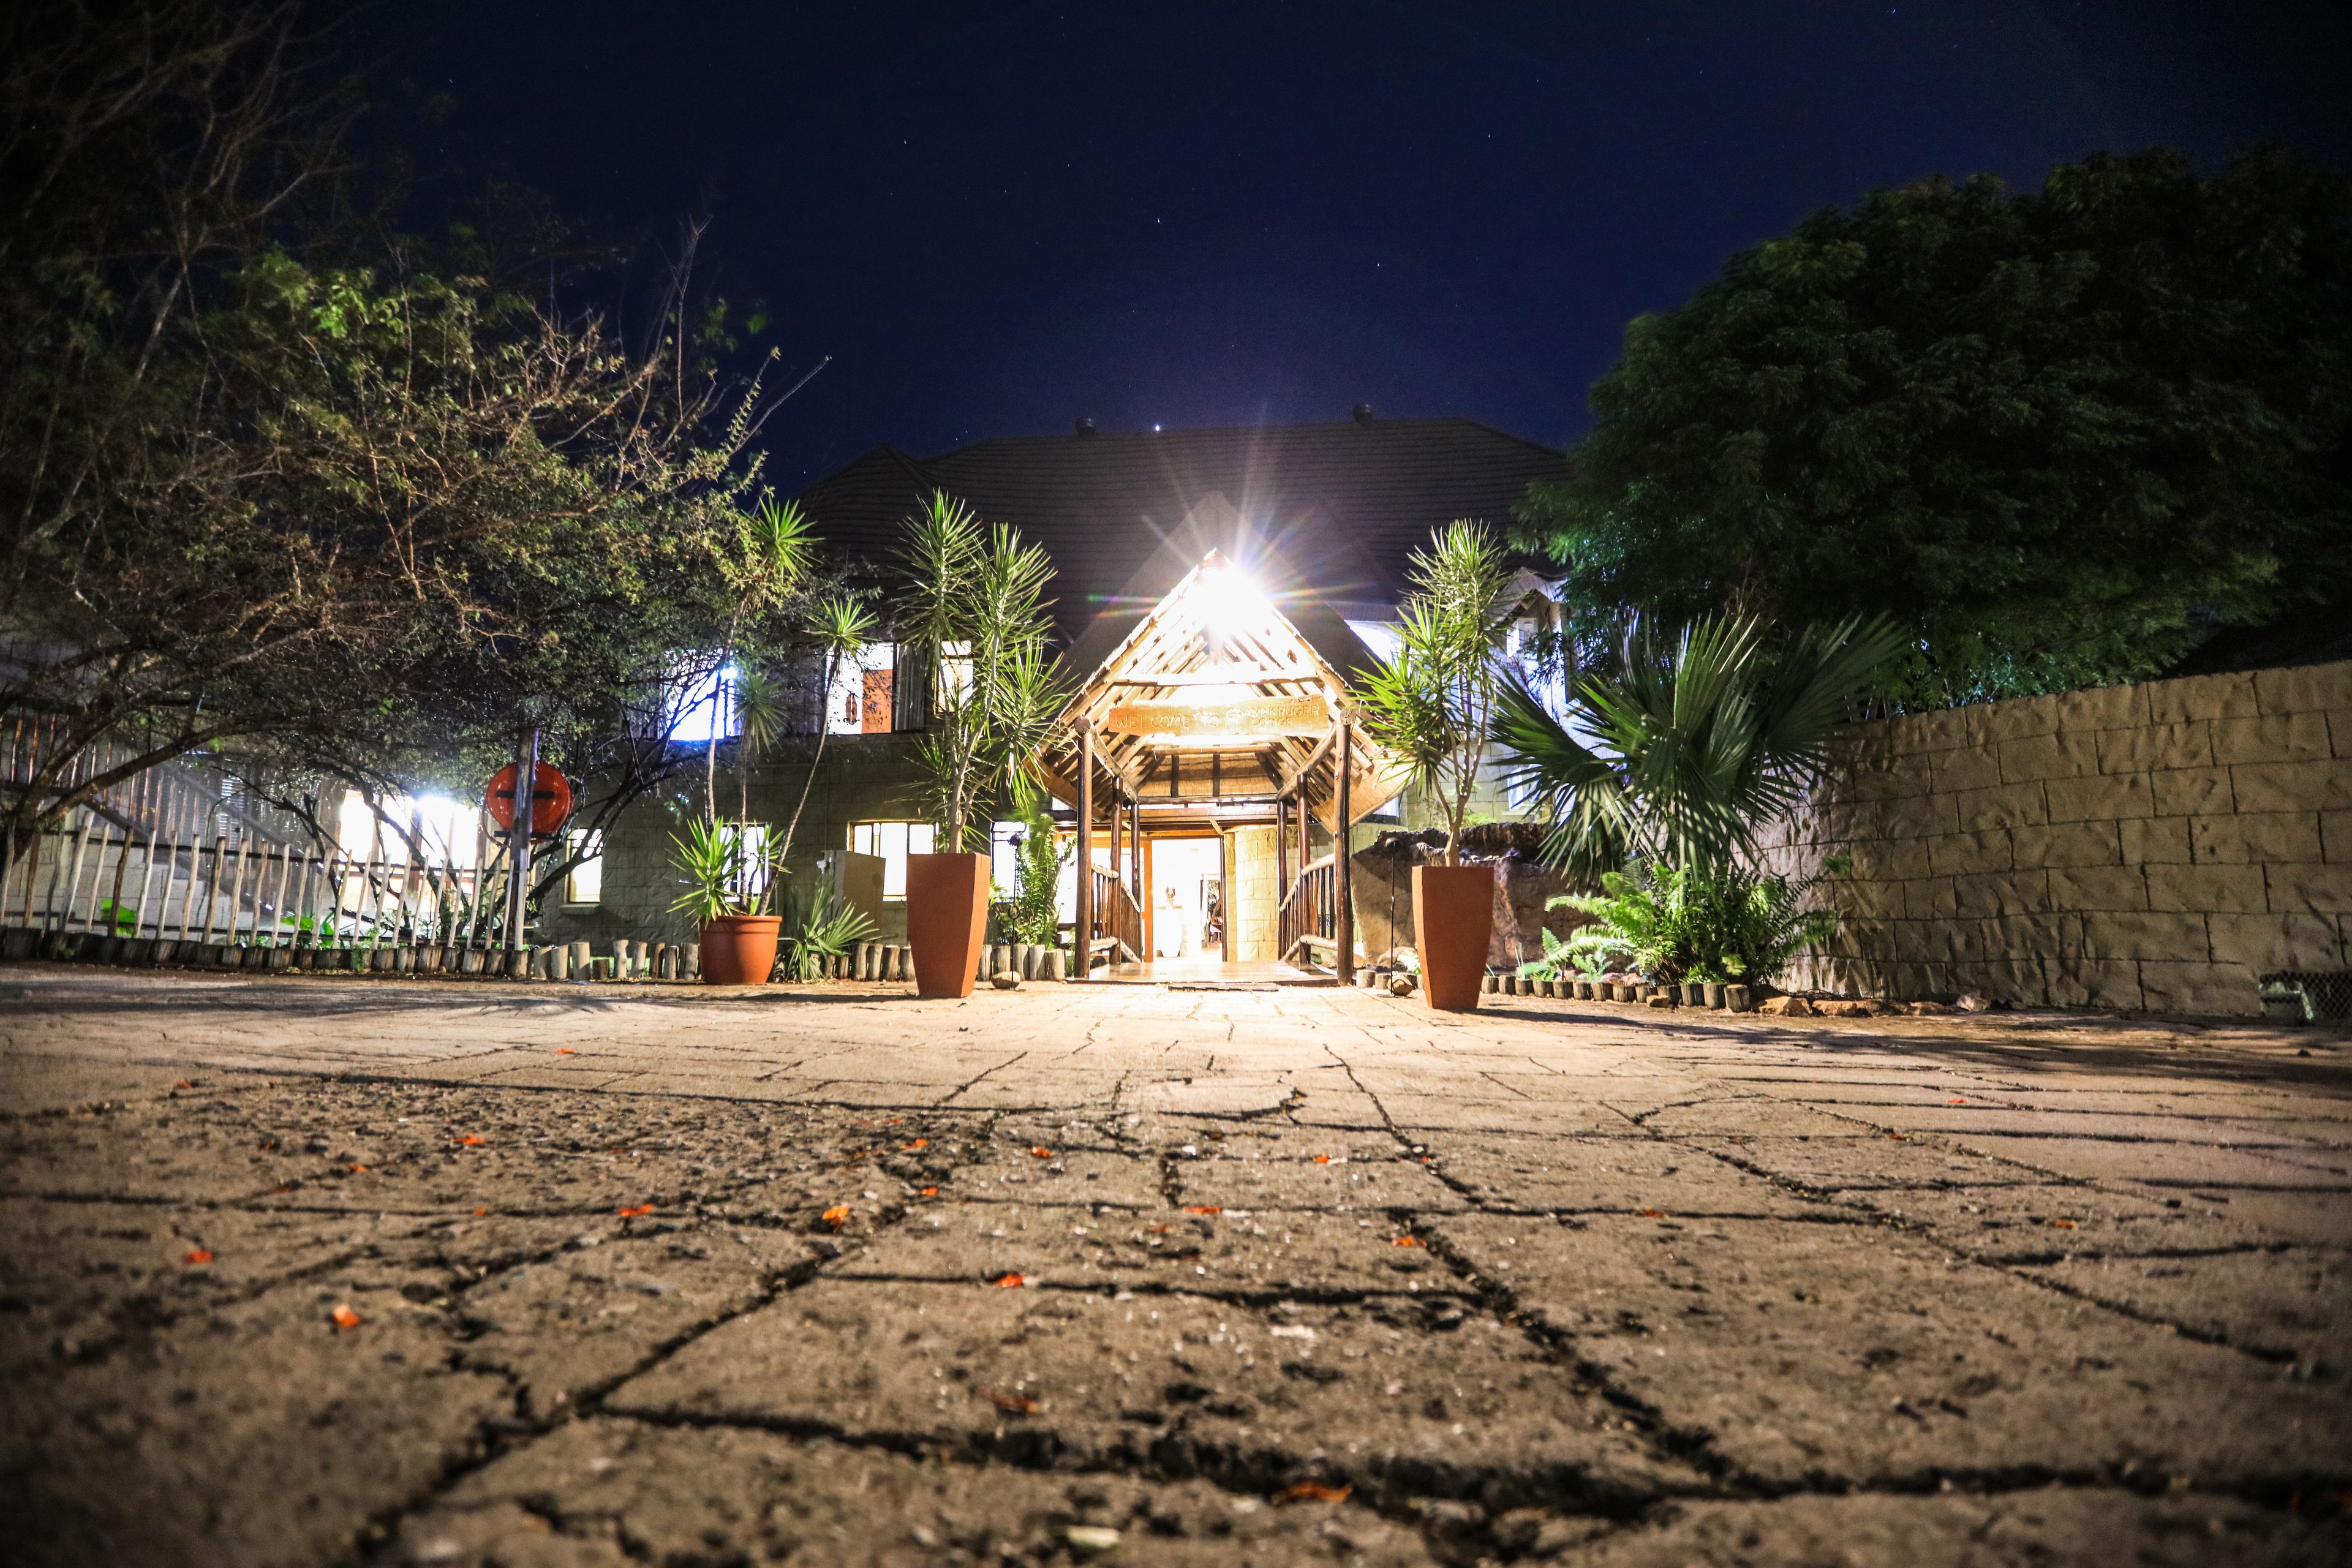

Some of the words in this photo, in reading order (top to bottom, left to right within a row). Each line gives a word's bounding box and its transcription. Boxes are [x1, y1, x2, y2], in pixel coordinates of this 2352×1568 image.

[1115, 715, 1190, 729] WELCOME
[1200, 714, 1219, 728] TO
[1252, 717, 1293, 726] LODGE
